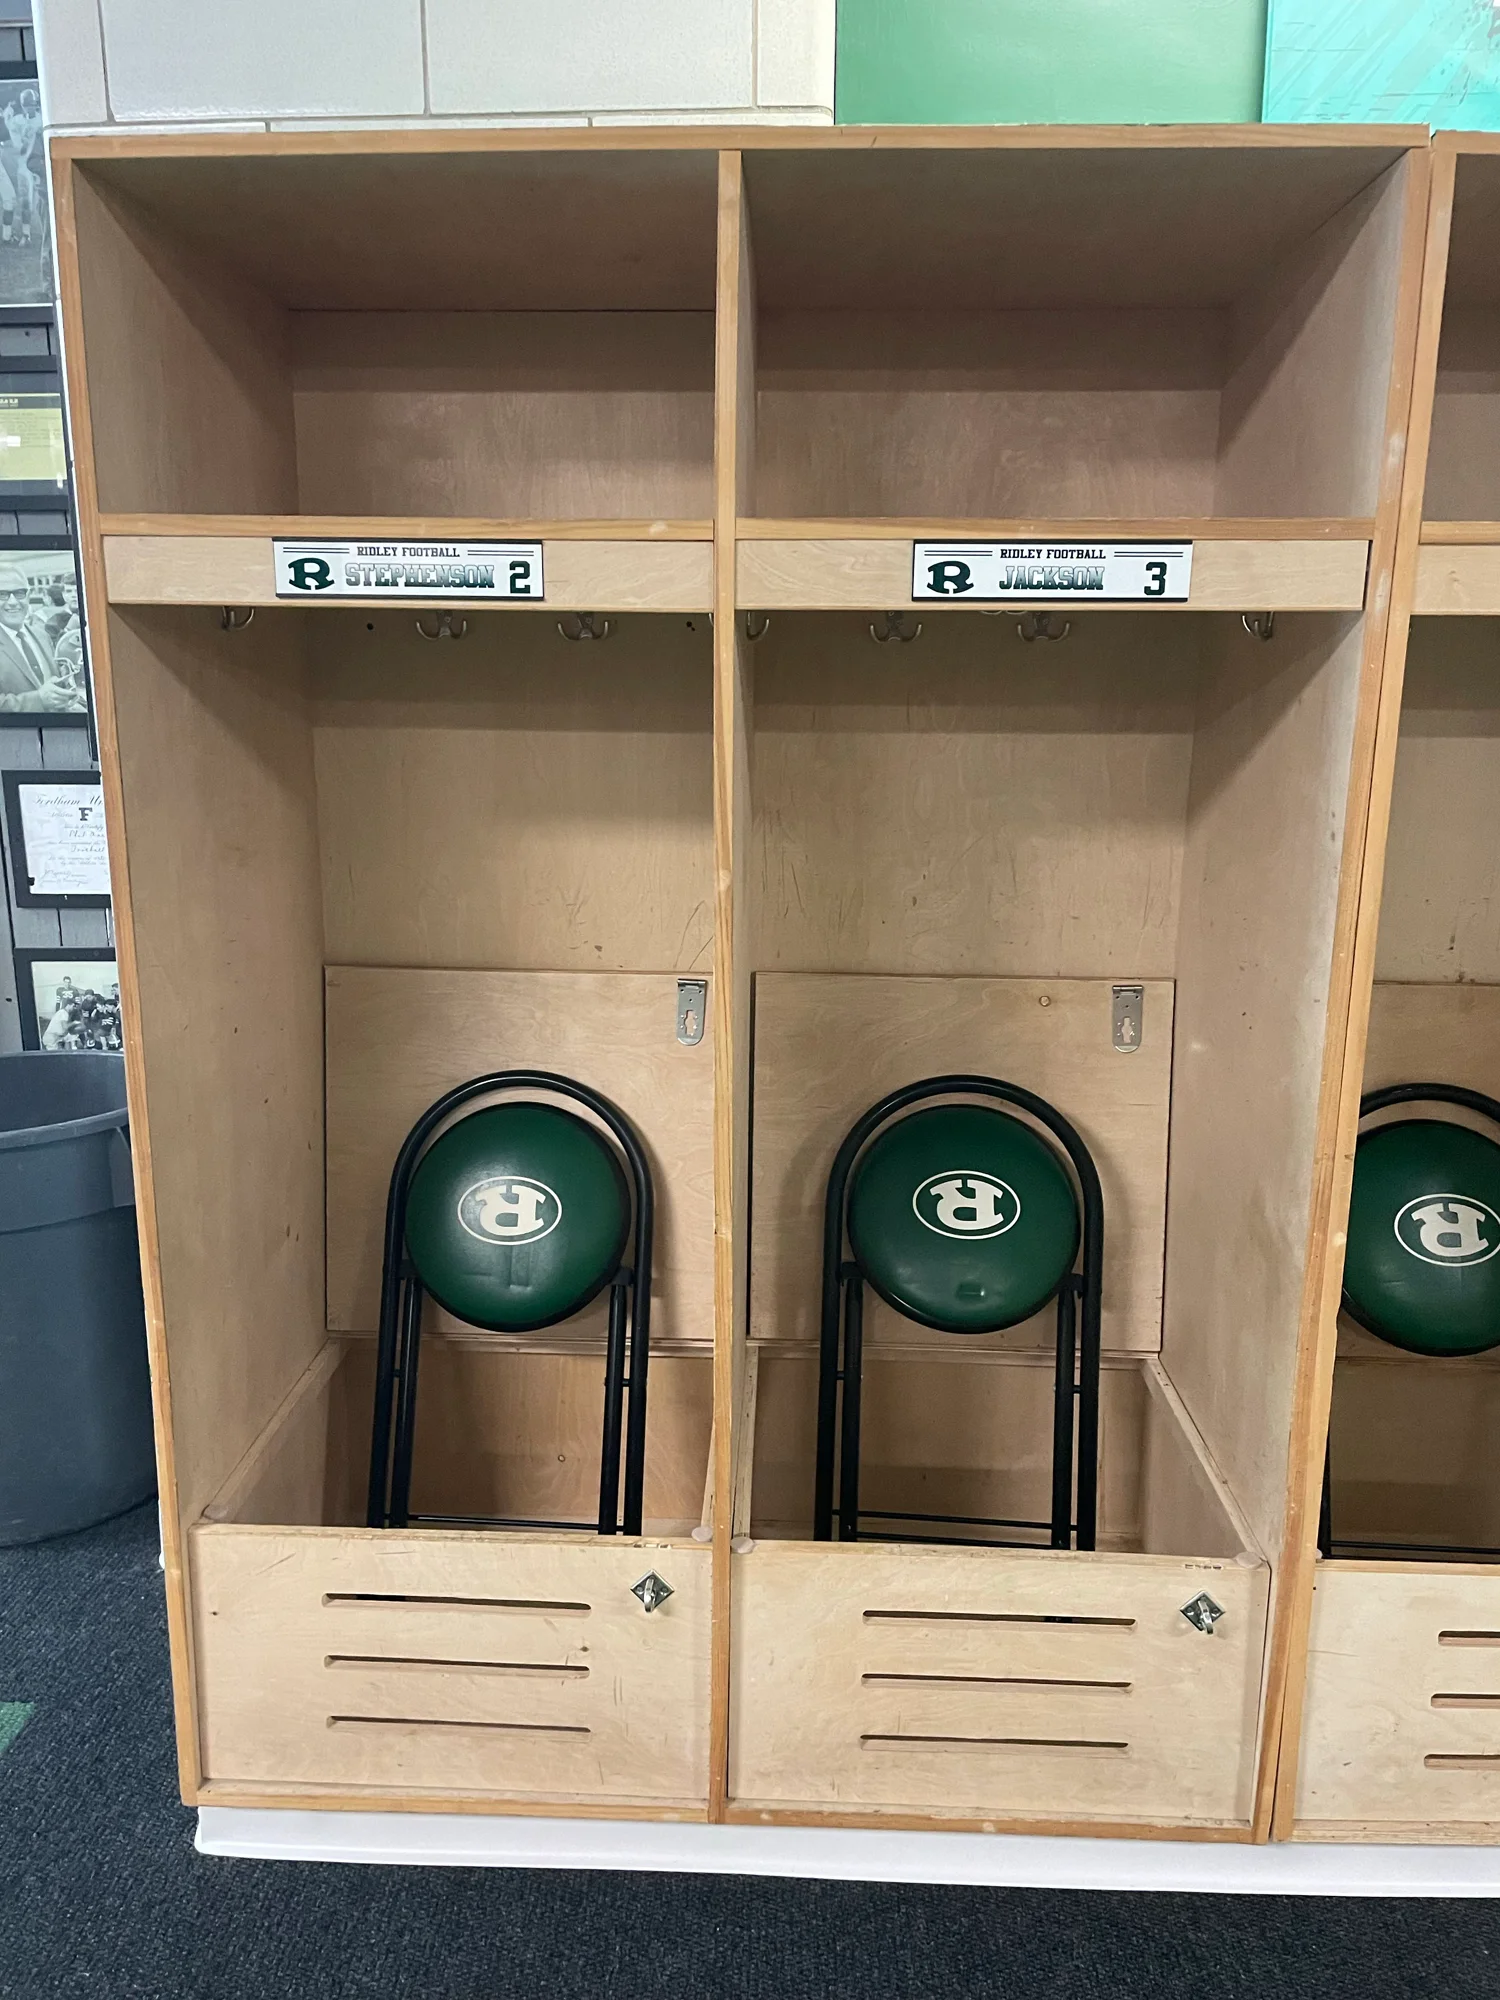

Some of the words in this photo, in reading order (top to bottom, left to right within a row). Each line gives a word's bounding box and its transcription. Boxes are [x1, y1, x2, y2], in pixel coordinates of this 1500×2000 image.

[357, 546, 398, 557] RIDLEY
[402, 547, 460, 558] FOOTBALL
[1000, 549, 1043, 559] RIDLEY
[1046, 550, 1106, 560] FOOTBALL
[288, 557, 335, 591] R
[345, 563, 495, 589] STEPHENSON
[509, 560, 531, 594] 2
[926, 560, 974, 595] R
[999, 566, 1105, 590] JACKSON
[1143, 561, 1168, 596] 3
[78, 807, 93, 821] F
